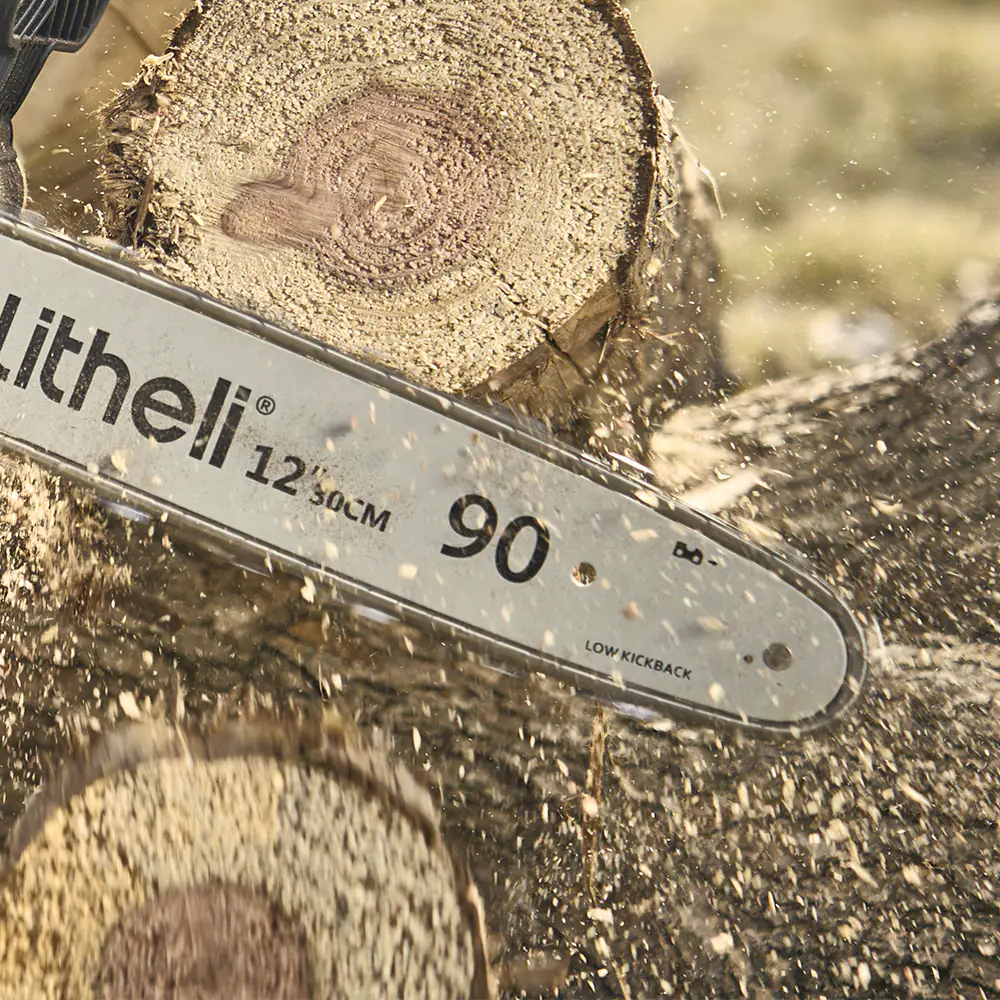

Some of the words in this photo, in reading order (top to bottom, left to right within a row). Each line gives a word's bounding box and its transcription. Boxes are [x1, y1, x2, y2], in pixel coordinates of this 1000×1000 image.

[440, 493, 551, 584] 90
[584, 639, 619, 658] LOW
[620, 649, 693, 680] KICKBACK
